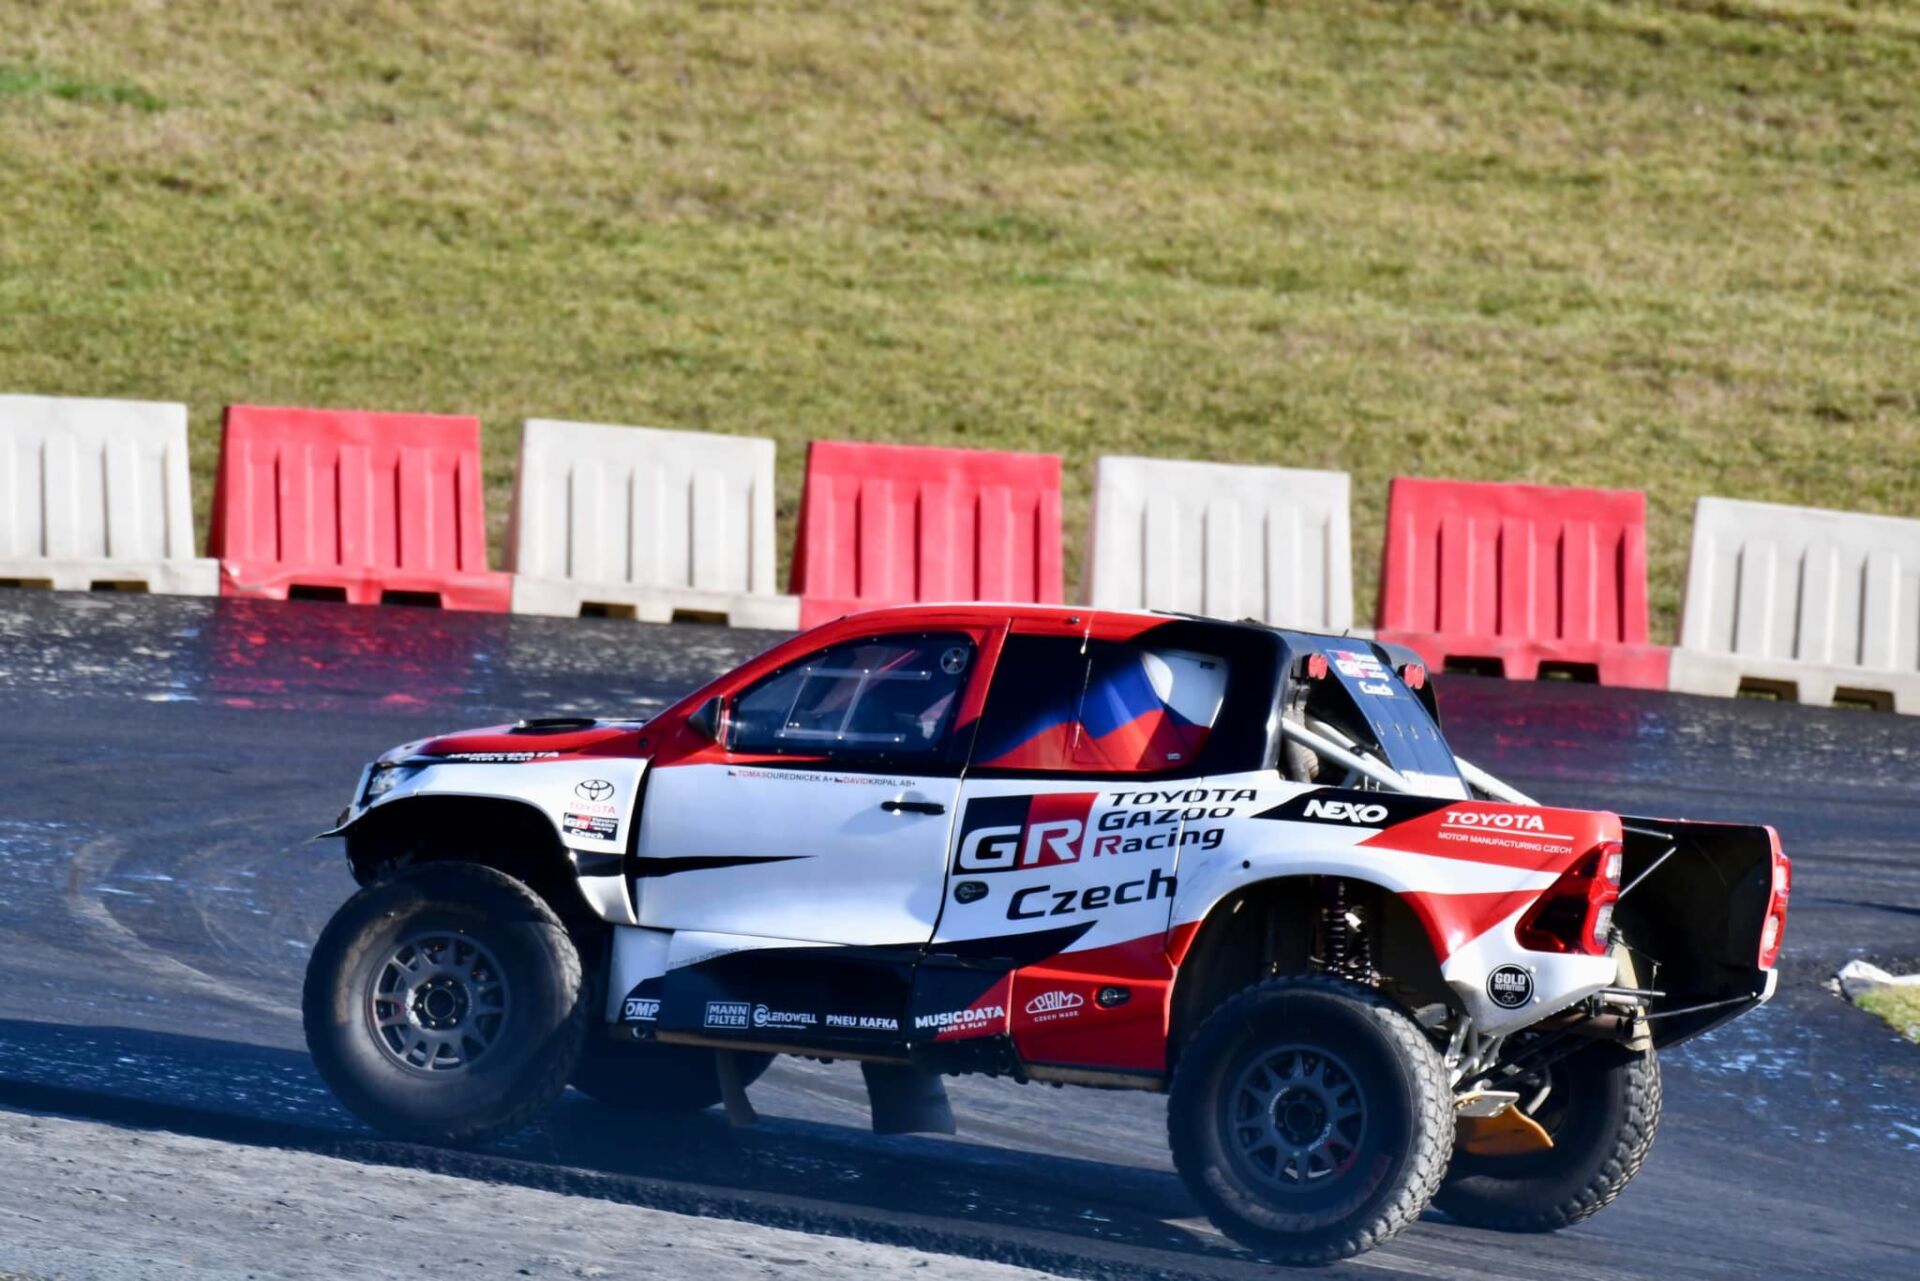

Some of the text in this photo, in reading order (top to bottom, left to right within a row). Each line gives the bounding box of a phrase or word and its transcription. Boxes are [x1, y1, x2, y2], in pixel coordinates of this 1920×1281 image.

[1109, 788, 1257, 807] TOYOTA
[568, 801, 616, 815] TOYOTA
[1303, 799, 1388, 823] NEXO
[1098, 807, 1235, 832] GAZOO
[1446, 811, 1544, 831] TOYOTA
[959, 819, 1083, 870] GR
[1092, 827, 1225, 858] Racing
[1438, 831, 1573, 855] MOTOR MANUFACTURING CZECH
[1006, 868, 1178, 920] Czech
[1495, 972, 1526, 985] GOLD
[625, 1001, 660, 1017] OMP
[709, 1004, 748, 1016] MANN
[1034, 990, 1074, 1011] PRIM
[707, 1014, 747, 1026] FILTER
[826, 1014, 899, 1030] PNEU KAFKA
[914, 1005, 1005, 1029] MUSICDATA
[968, 1020, 988, 1029] PLAY
